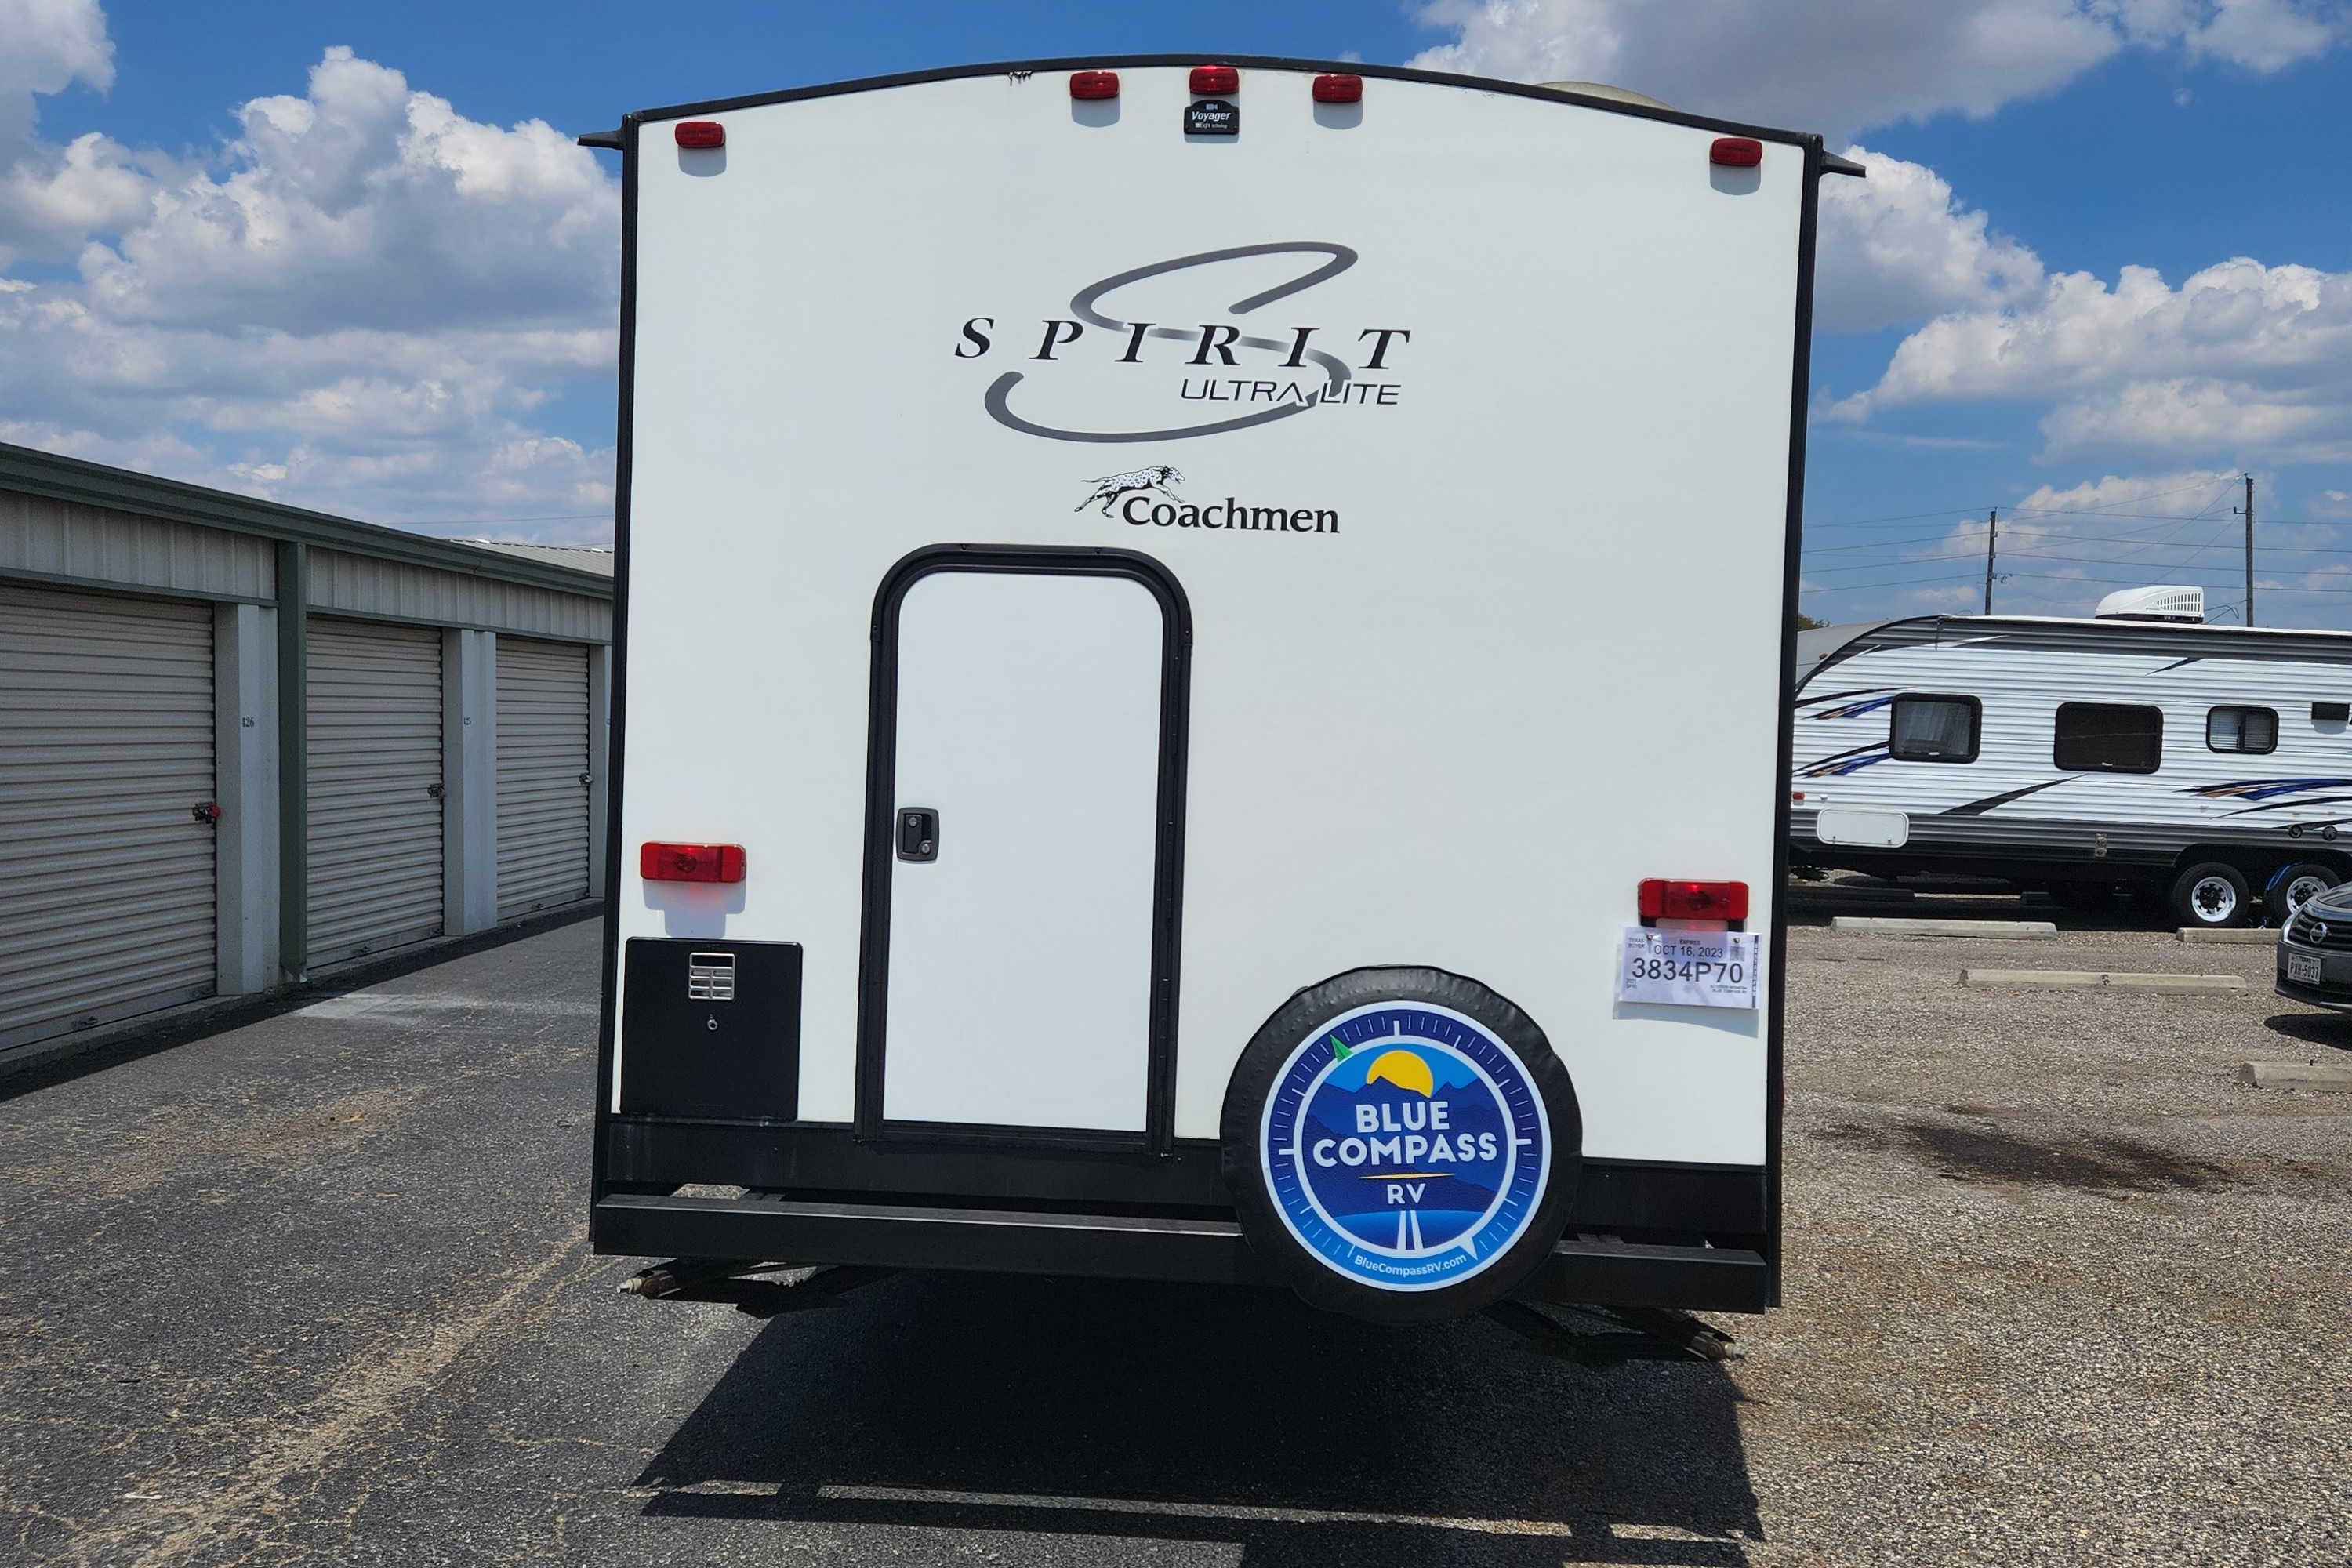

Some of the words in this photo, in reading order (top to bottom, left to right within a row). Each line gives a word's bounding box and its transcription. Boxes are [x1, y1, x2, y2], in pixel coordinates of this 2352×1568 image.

[1192, 111, 1232, 122] Voyager
[954, 317, 1410, 370] SPIRIT
[1181, 378, 1308, 405] ULTRA
[1319, 381, 1402, 405] LITE
[1123, 496, 1341, 534] Coachmen
[1654, 944, 1677, 956] OCT
[1680, 946, 1695, 957] 16,
[1698, 946, 1724, 958] 2023
[1632, 957, 1744, 984] 3834P70
[1355, 1101, 1450, 1134] BLUE
[1312, 1132, 1498, 1167] COMPASS
[1386, 1183, 1427, 1205] RV
[1354, 1254, 1468, 1278] BlueCompassRV.com
